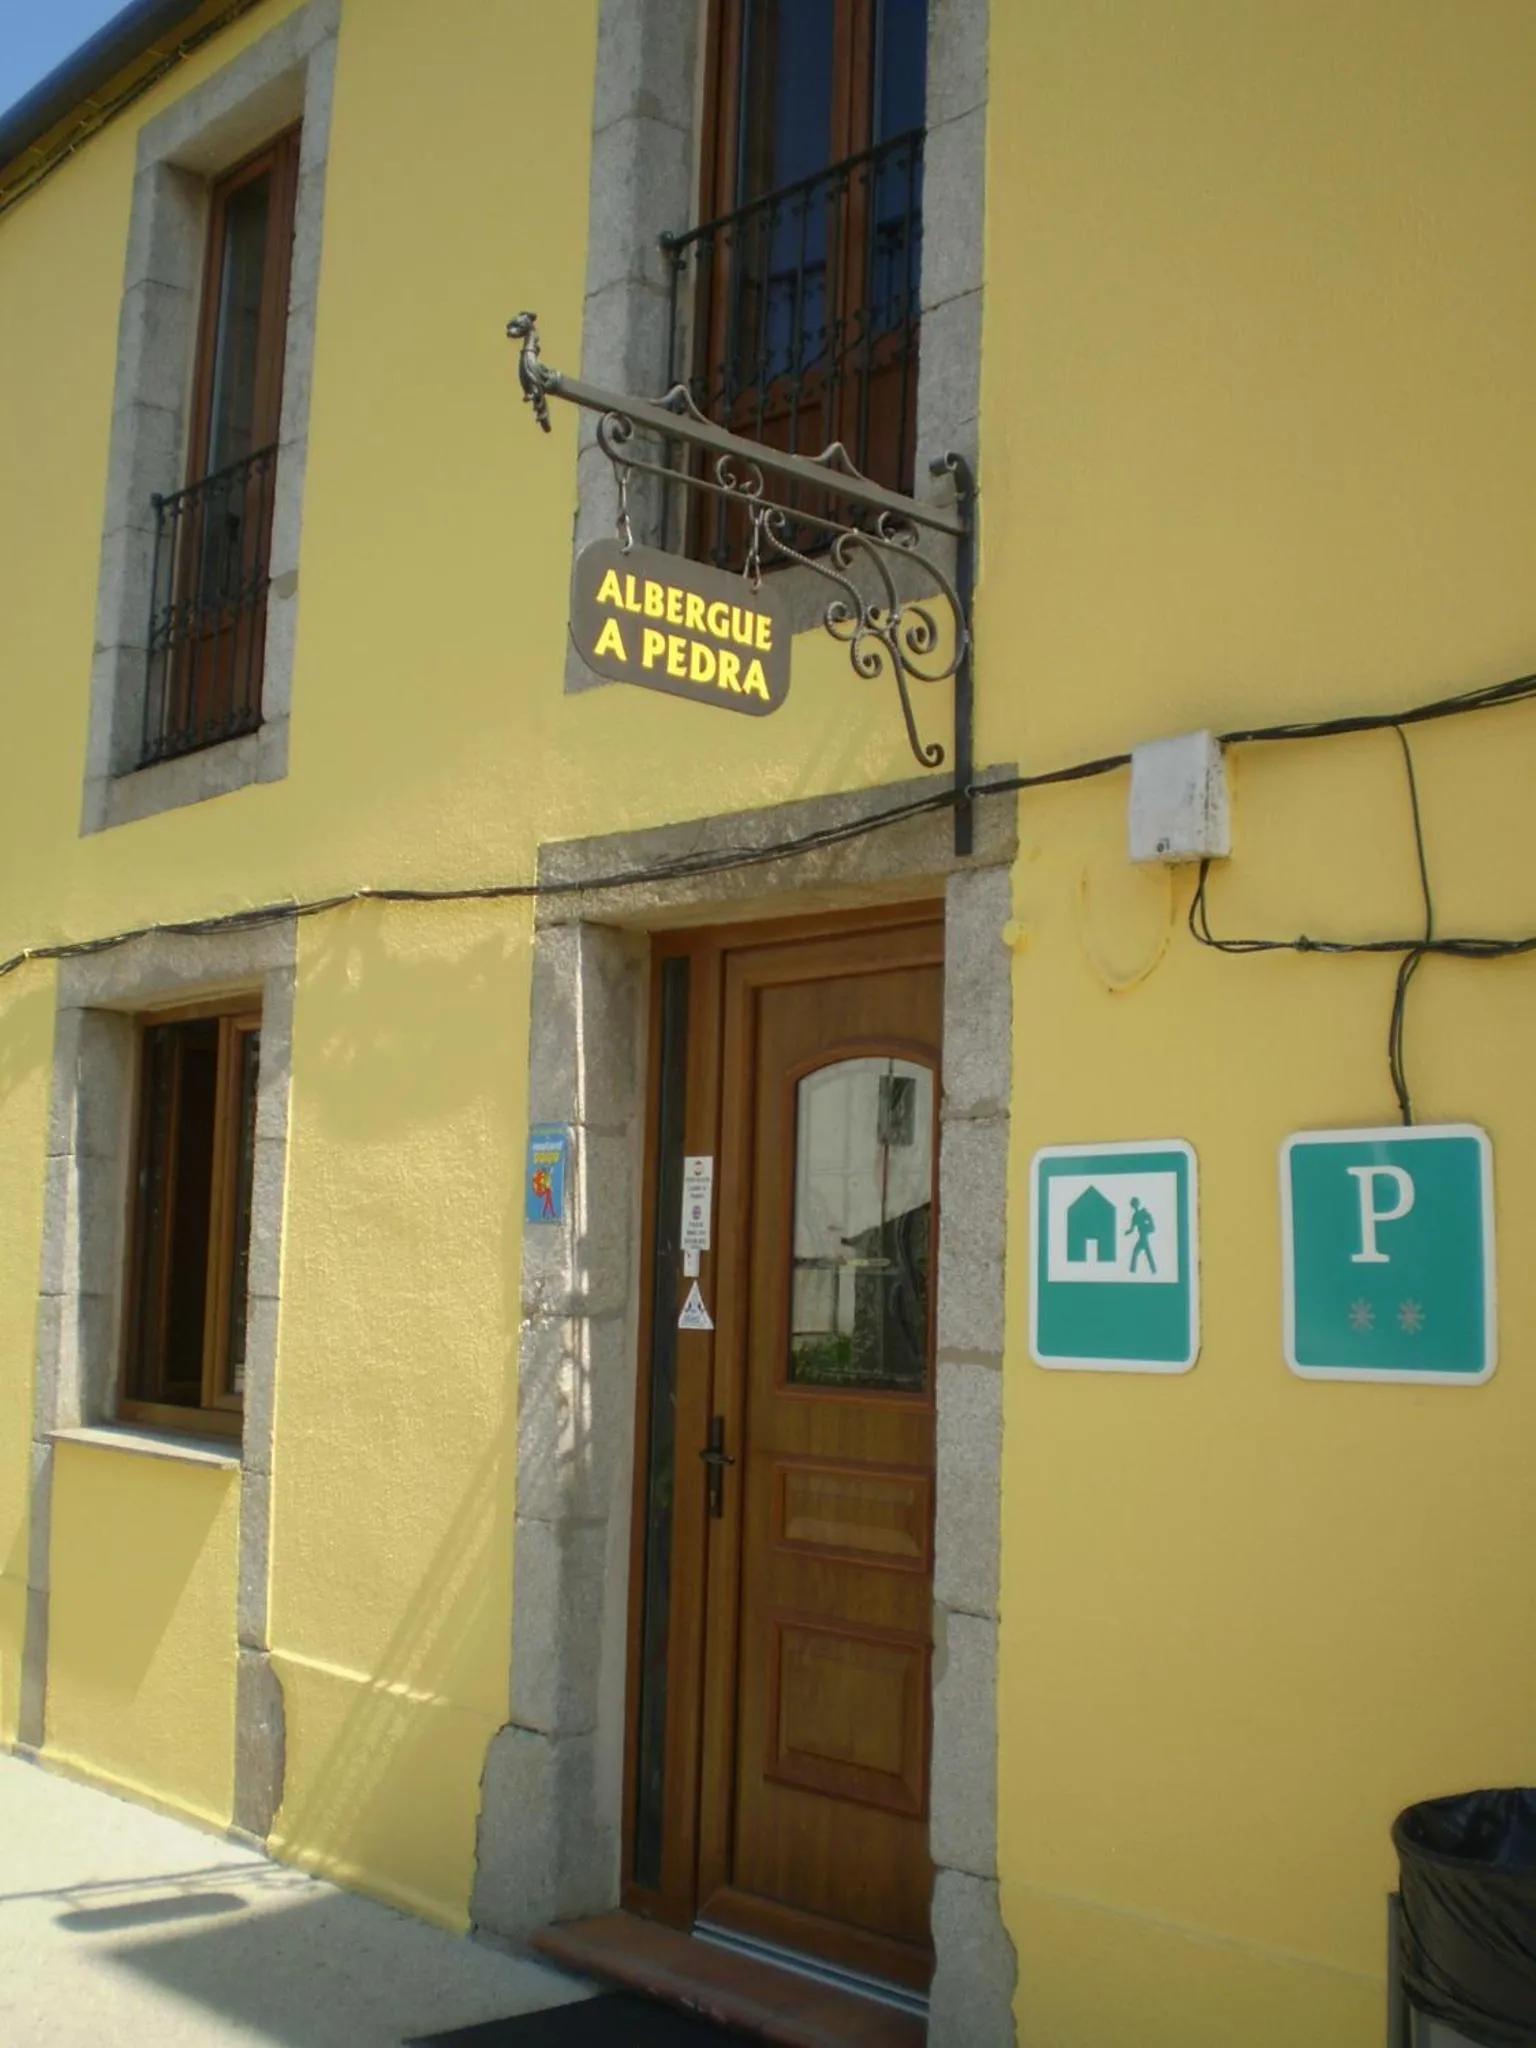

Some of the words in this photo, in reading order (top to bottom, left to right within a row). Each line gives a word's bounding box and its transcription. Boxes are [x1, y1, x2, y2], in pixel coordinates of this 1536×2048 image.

[596, 568, 773, 651] ALBERGUE
[594, 617, 627, 662] A
[642, 628, 770, 700] PEDRA
[1346, 1164, 1415, 1263] P
